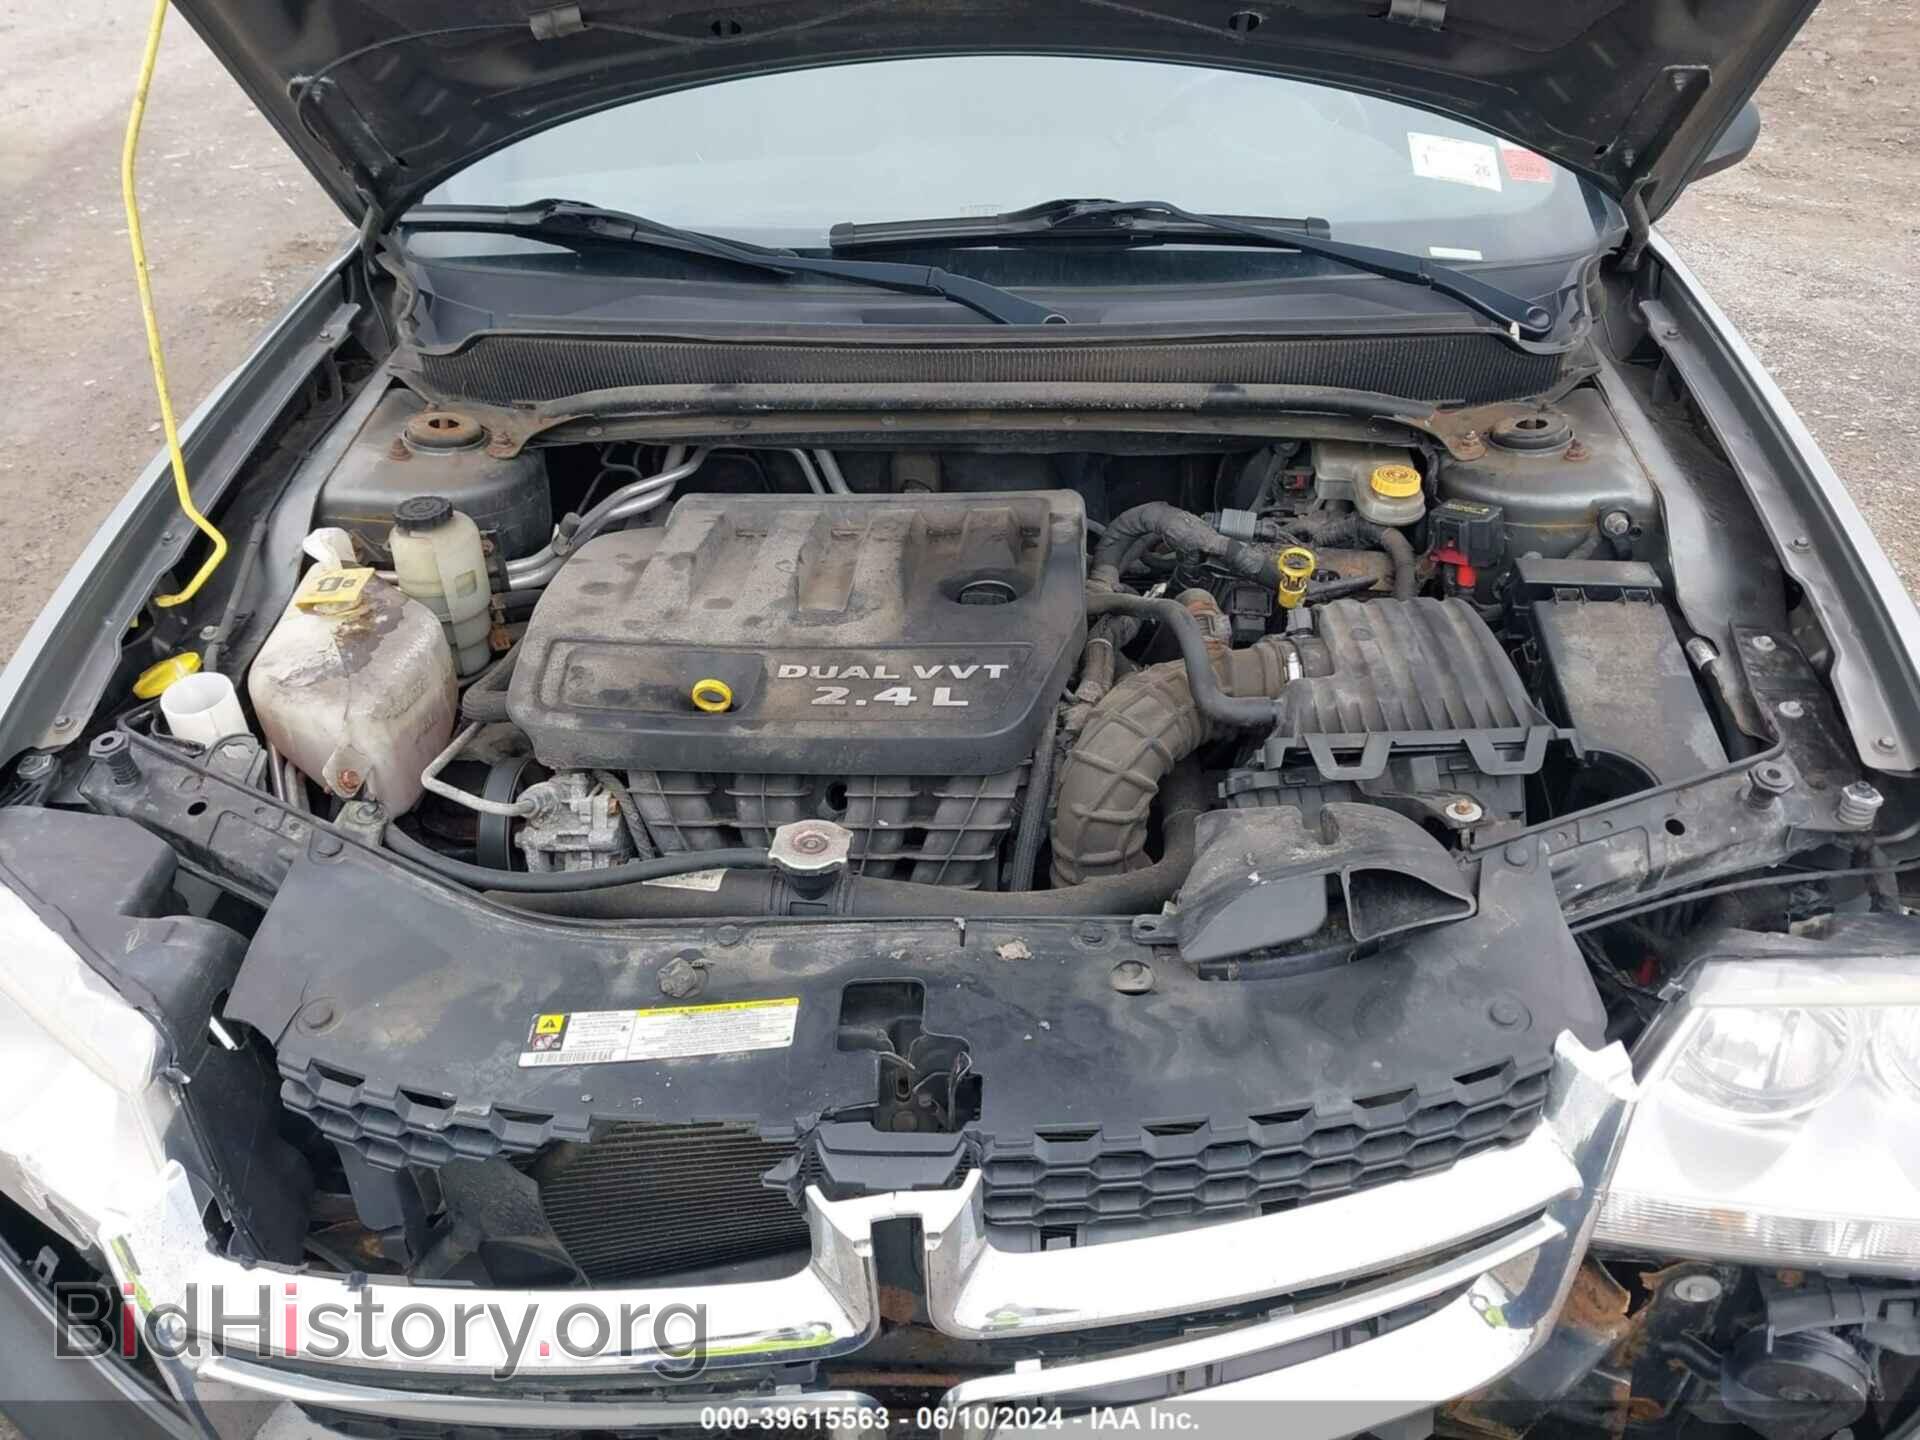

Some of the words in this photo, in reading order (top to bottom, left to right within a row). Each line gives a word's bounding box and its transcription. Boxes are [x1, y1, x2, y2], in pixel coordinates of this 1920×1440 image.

[777, 665, 900, 679] DUAL
[913, 665, 1009, 679] VVT
[811, 687, 917, 706] 2.4
